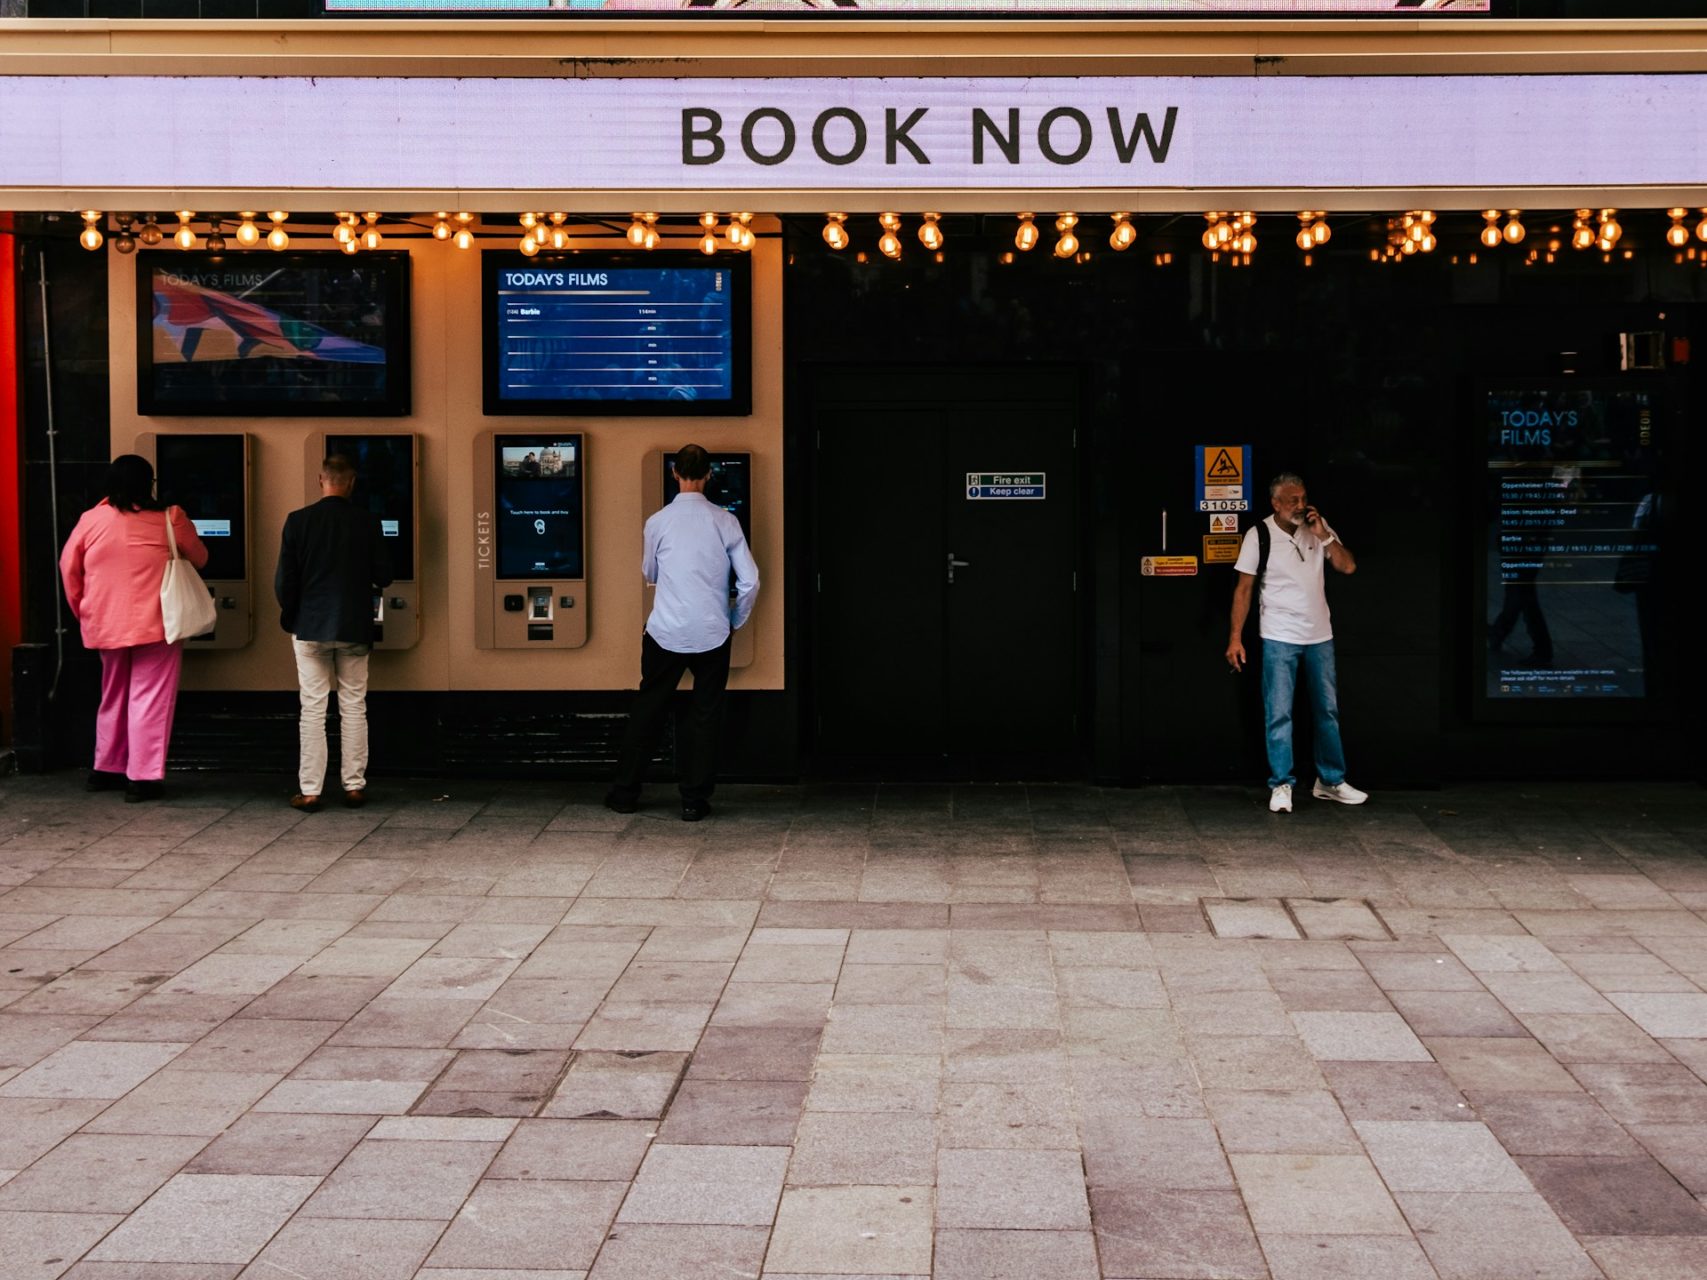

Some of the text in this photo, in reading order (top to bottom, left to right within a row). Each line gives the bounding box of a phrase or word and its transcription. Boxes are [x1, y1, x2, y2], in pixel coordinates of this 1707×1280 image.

[681, 106, 1179, 165] BOOK NOW
[161, 274, 263, 287] TODAY'S FILMS
[506, 273, 608, 286] TODAY'S FILMS
[1501, 411, 1578, 427] TODAY'S
[1501, 430, 1551, 445] FILMS
[993, 476, 1031, 485] Fire exit
[990, 487, 1034, 496] Keep clear
[1202, 501, 1246, 510] 31055
[478, 511, 490, 569] TICKETS
